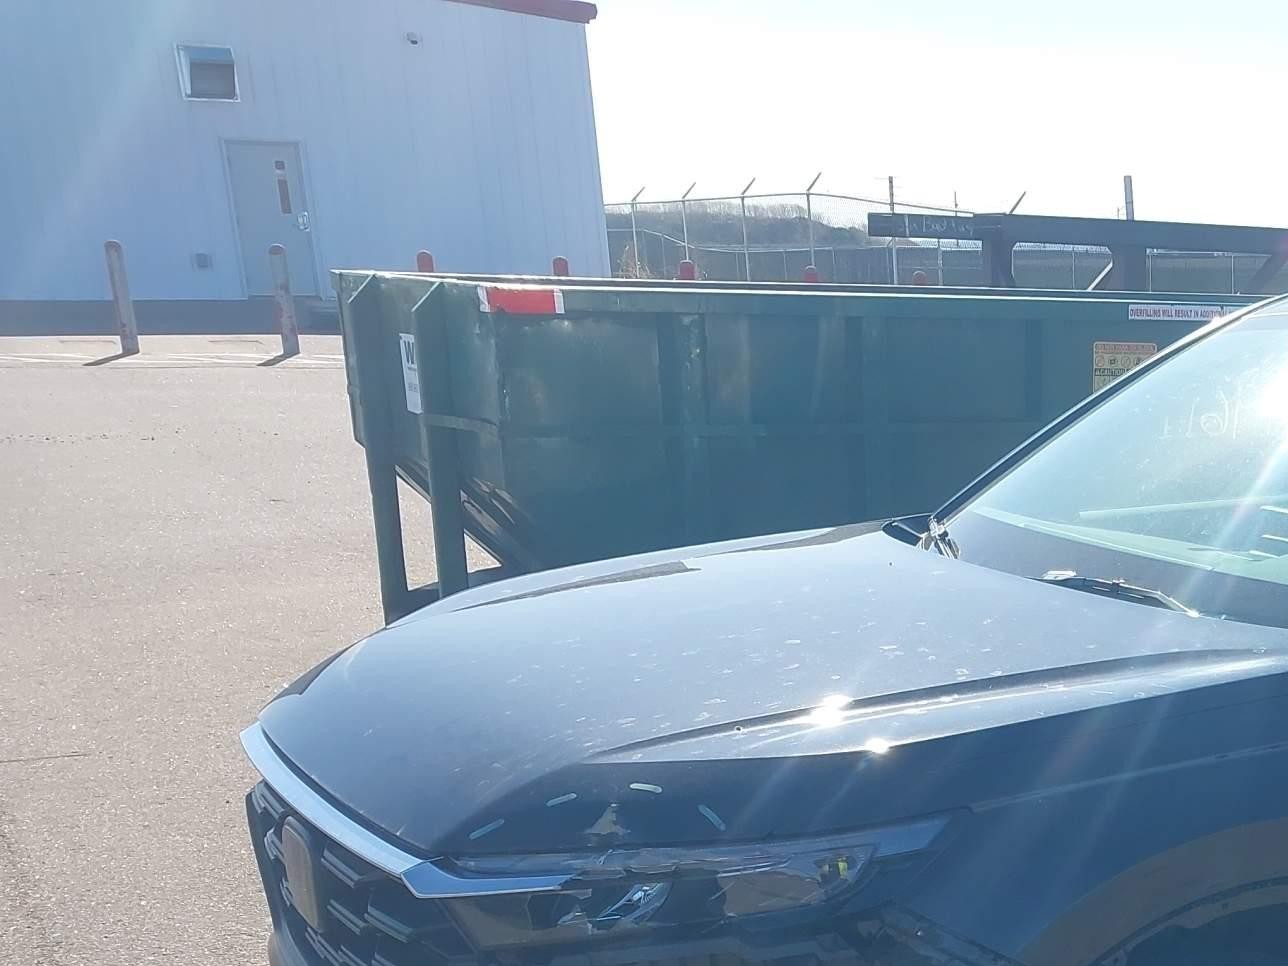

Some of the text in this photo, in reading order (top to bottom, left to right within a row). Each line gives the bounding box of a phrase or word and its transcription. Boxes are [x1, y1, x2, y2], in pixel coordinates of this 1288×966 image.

[1129, 308, 1162, 318] OVERFILLING
[1162, 308, 1174, 318] WILL
[1174, 309, 1193, 318] RESULT
[1193, 310, 1200, 318] IN
